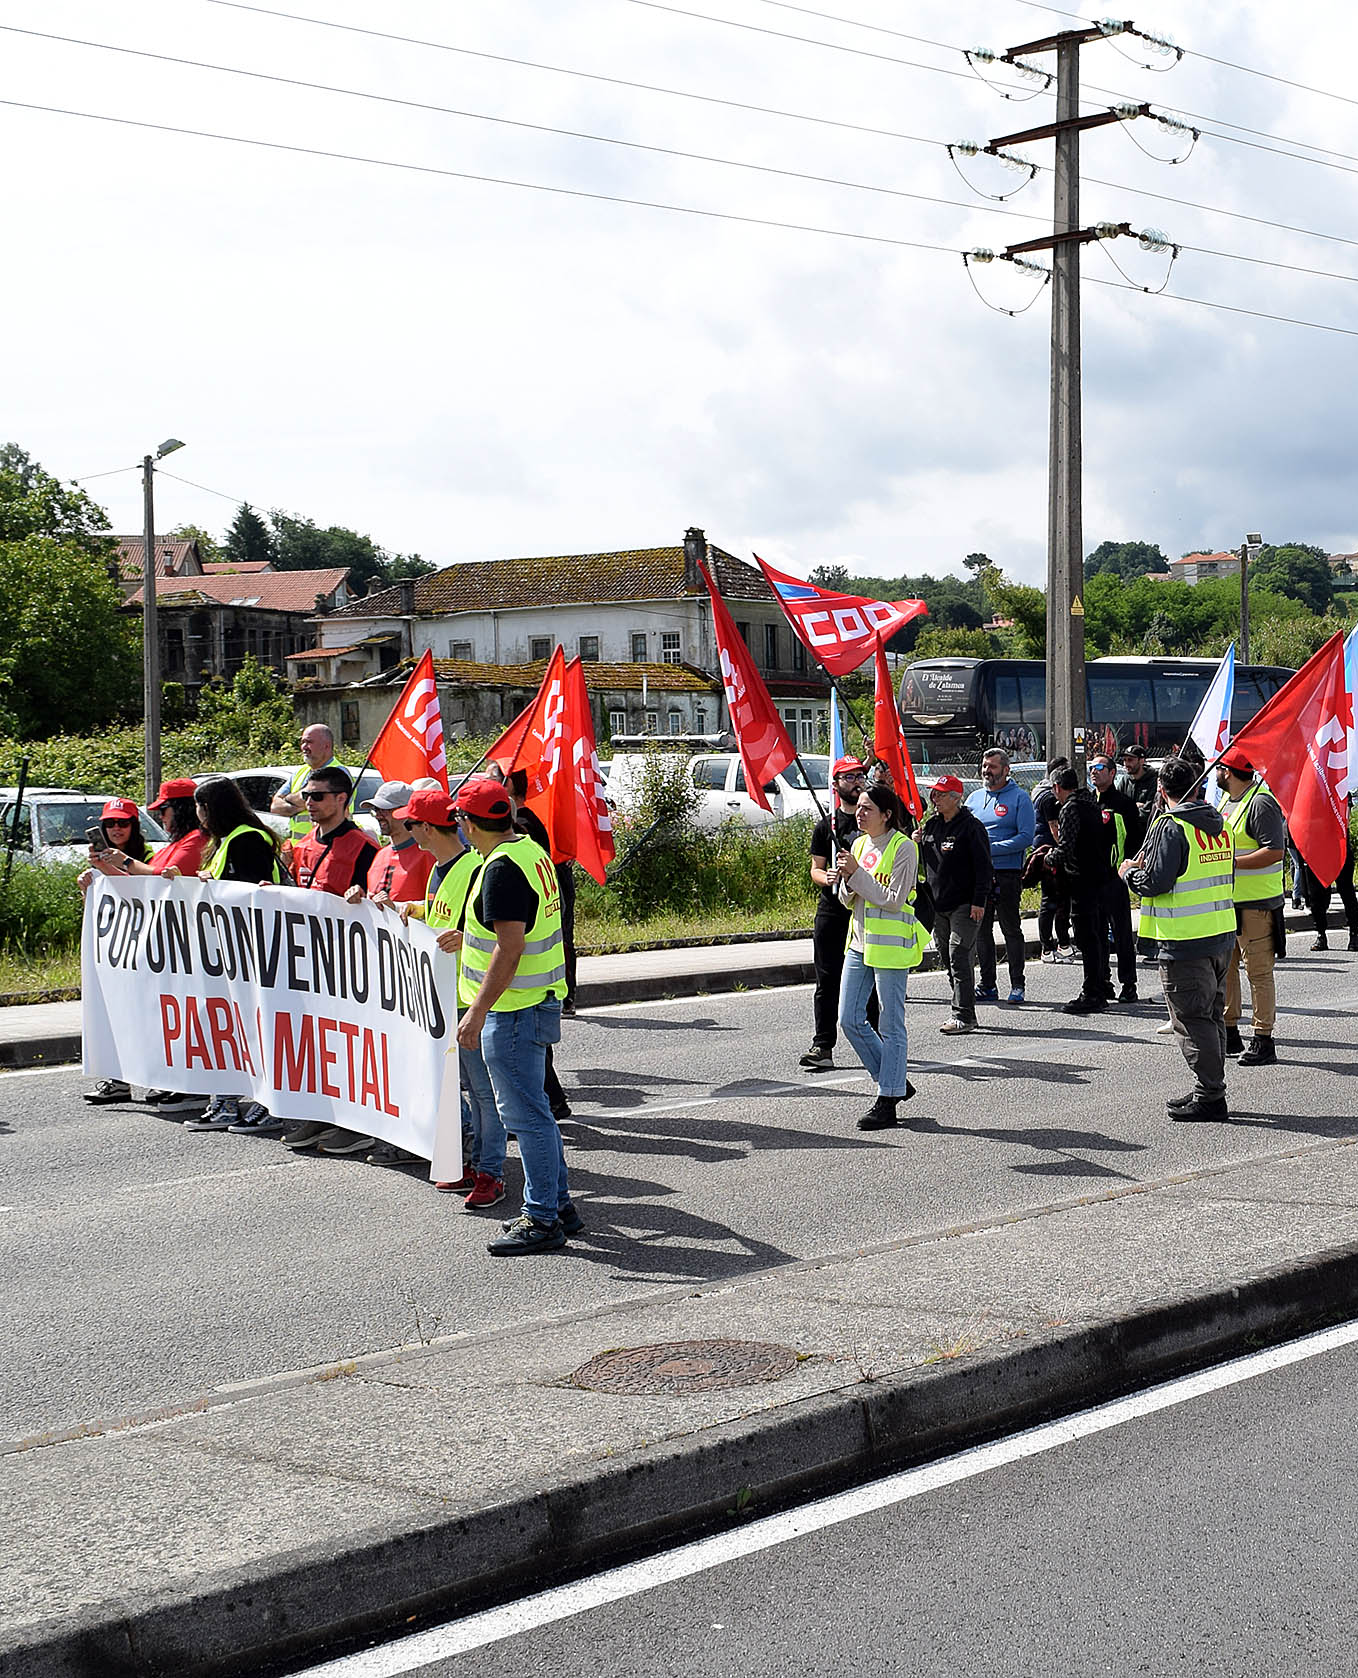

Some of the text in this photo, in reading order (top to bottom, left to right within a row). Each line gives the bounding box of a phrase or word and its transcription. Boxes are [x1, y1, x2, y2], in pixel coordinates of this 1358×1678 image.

[796, 601, 904, 647] COO
[97, 894, 446, 1040] POR UN CONVENIO DIGNO
[273, 1011, 400, 1118] METAL
